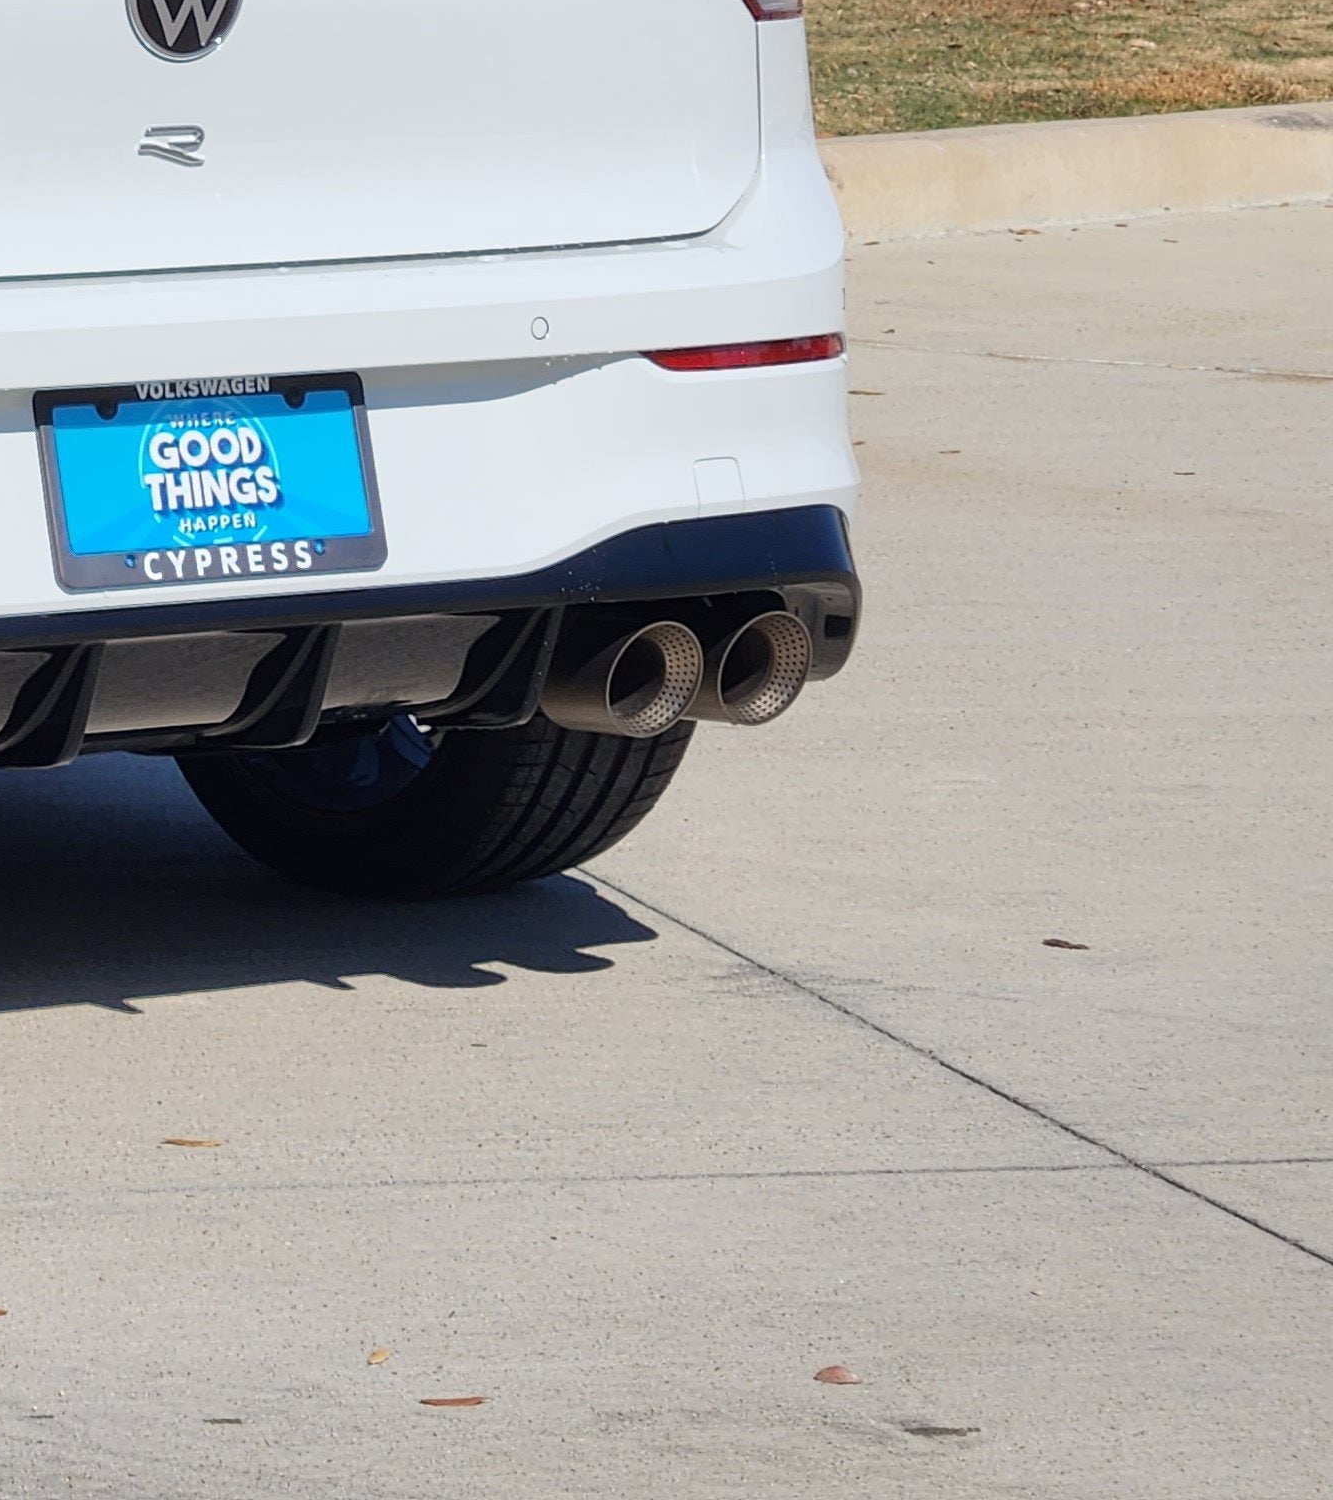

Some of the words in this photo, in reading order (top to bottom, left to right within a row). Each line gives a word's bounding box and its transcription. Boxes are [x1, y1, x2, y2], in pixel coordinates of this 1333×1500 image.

[136, 376, 271, 400] VOLKSWAGEN
[167, 411, 237, 429] WHERE
[149, 427, 263, 470] GOOD
[143, 466, 278, 511] THINGS
[179, 512, 257, 533] HAPPEN
[143, 540, 313, 581] CYPRESS
